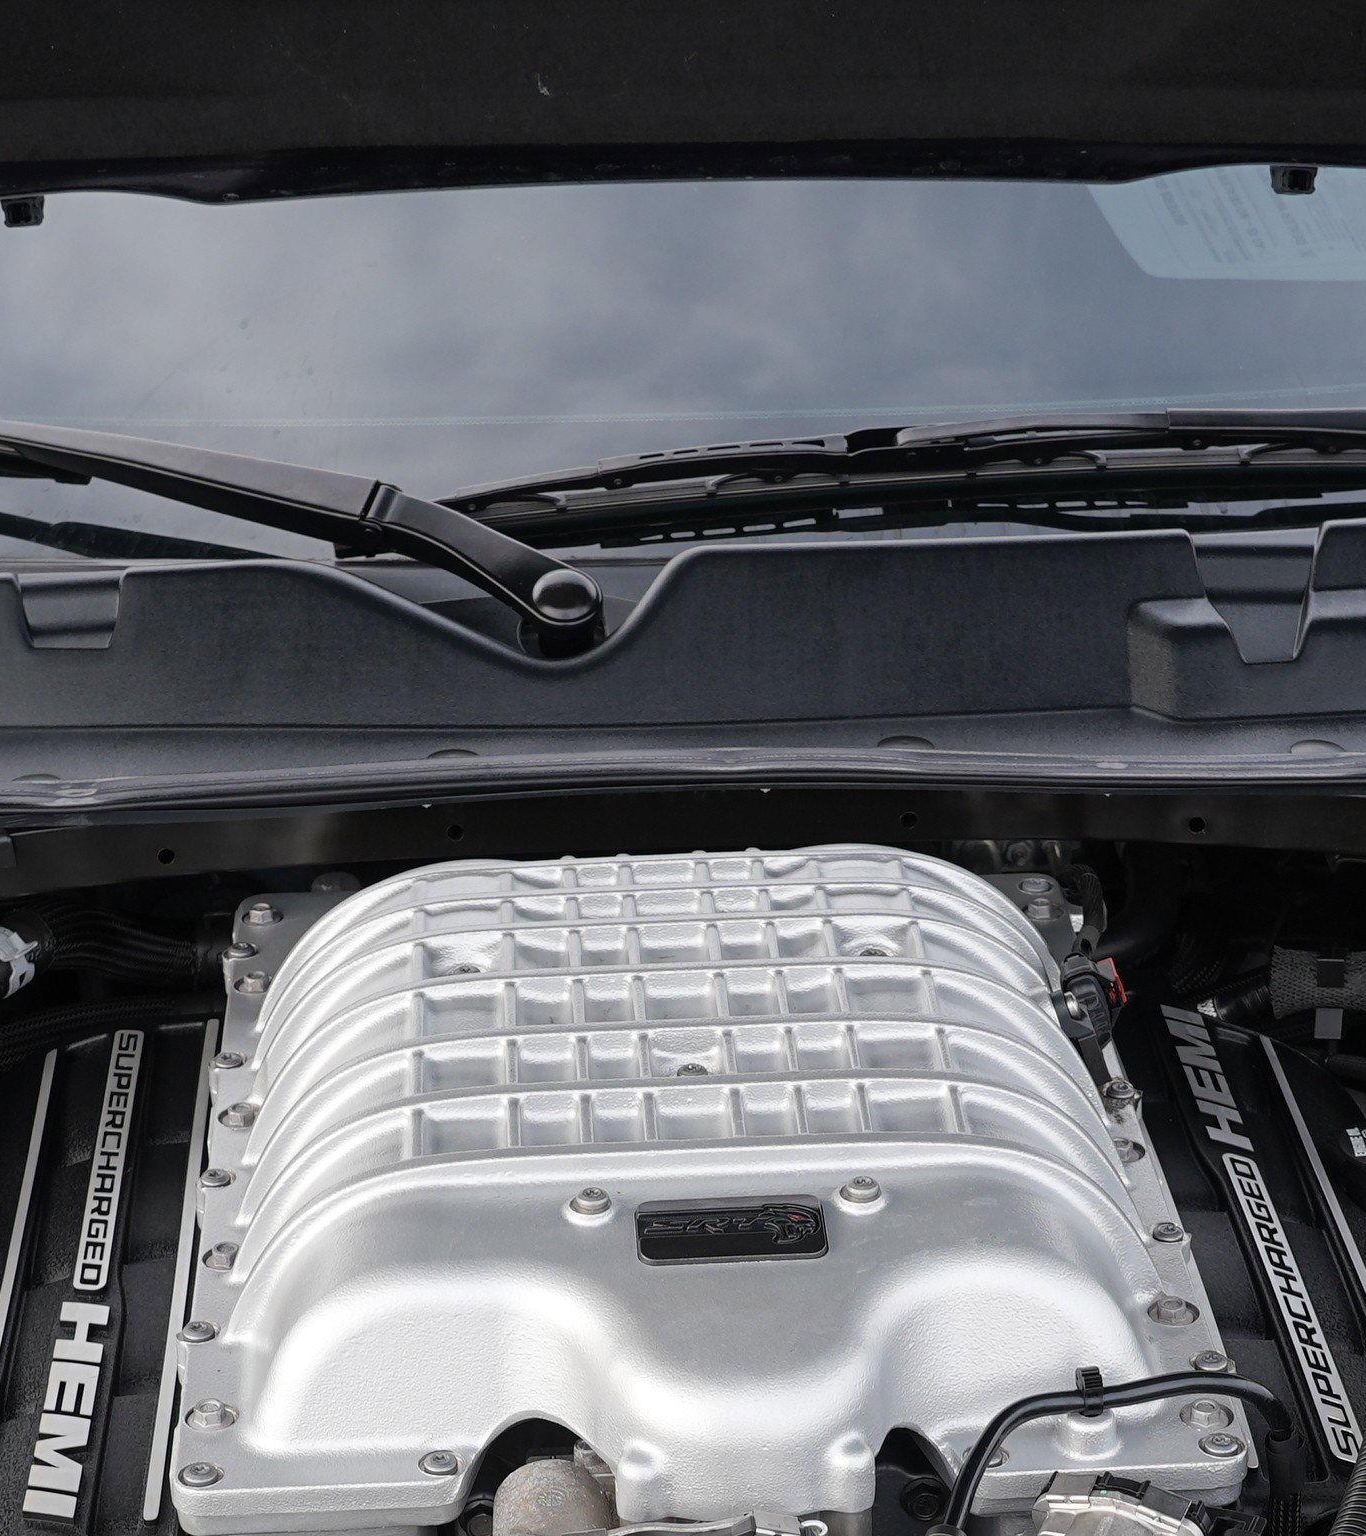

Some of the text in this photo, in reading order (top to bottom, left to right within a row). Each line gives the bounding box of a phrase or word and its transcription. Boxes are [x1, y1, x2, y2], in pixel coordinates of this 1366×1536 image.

[78, 1031, 141, 1287] SUPERCHARGED
[1161, 1004, 1254, 1152] HEMI
[643, 1211, 772, 1235] SRT
[1226, 1157, 1360, 1462] SUPERCHARGED
[22, 1301, 112, 1519] HEMI
